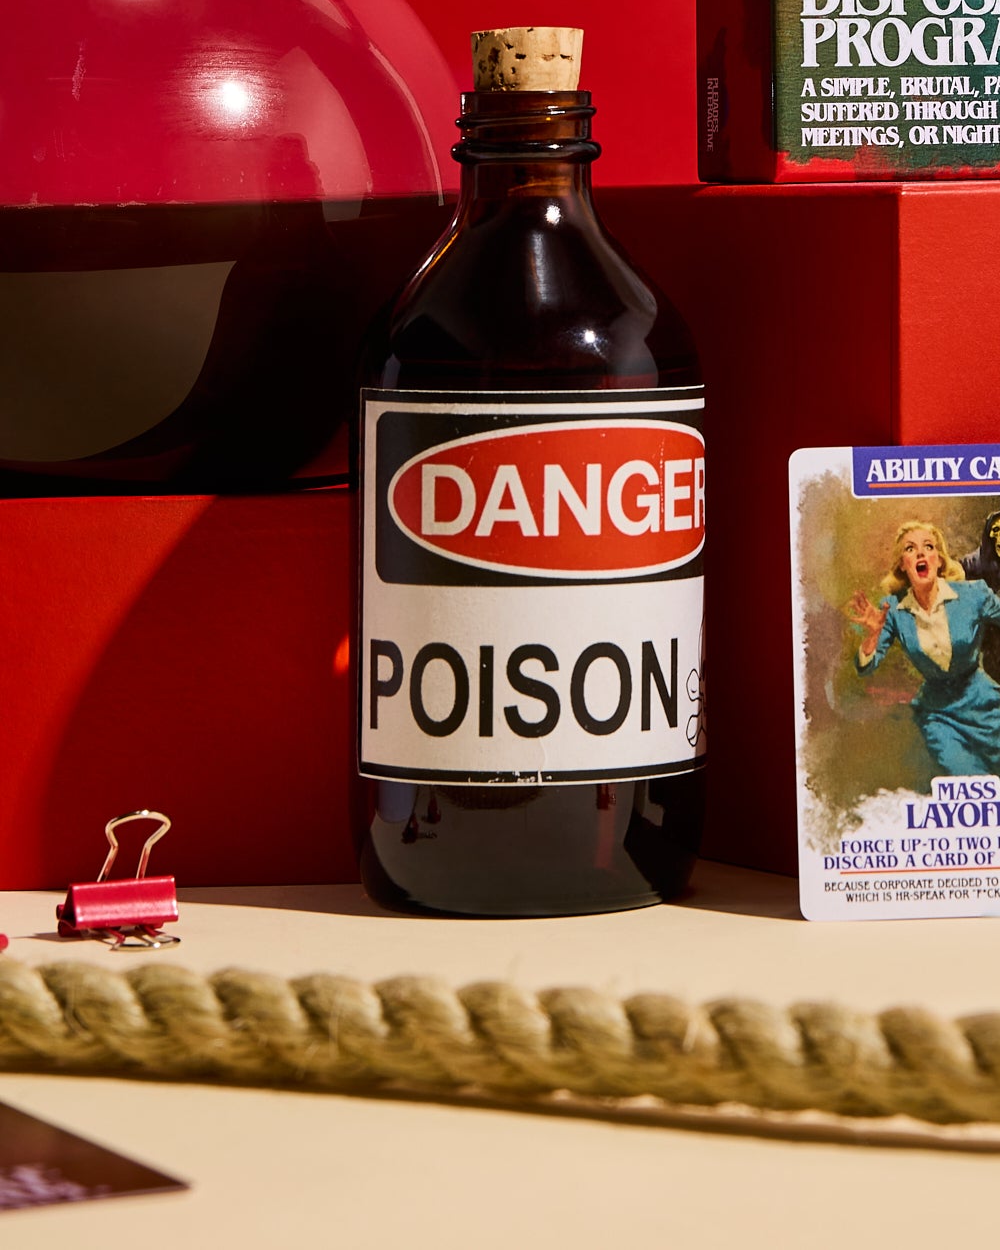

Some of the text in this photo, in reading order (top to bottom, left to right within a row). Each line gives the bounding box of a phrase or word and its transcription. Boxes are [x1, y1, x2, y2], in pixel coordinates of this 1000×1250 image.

[801, 77, 817, 98] A
[820, 76, 896, 99] SIMPLE,
[899, 75, 980, 99] BRUTAL,
[801, 101, 900, 123] SUFFERED
[901, 100, 999, 121] THROUGH
[801, 126, 905, 149] MEETINGS,
[908, 125, 941, 146] OR
[865, 456, 964, 482] ABILITY
[369, 638, 678, 738] POISON
[937, 781, 997, 801] MASS
[841, 839, 894, 854] FORCE
[900, 837, 950, 852] UP-TO
[956, 836, 991, 851] TWO
[823, 854, 899, 870] DISCARD
[905, 854, 916, 867] A
[922, 852, 968, 867] CARD
[974, 851, 996, 866] OF
[824, 880, 871, 892] BECAUSE
[873, 878, 934, 891] CORPORATE
[937, 877, 983, 889] DECIDED
[986, 876, 999, 887] TO
[846, 891, 879, 903] WHICH
[883, 891, 893, 901] IS
[896, 889, 946, 901] HR-SPEAK
[949, 888, 970, 900] FOR
